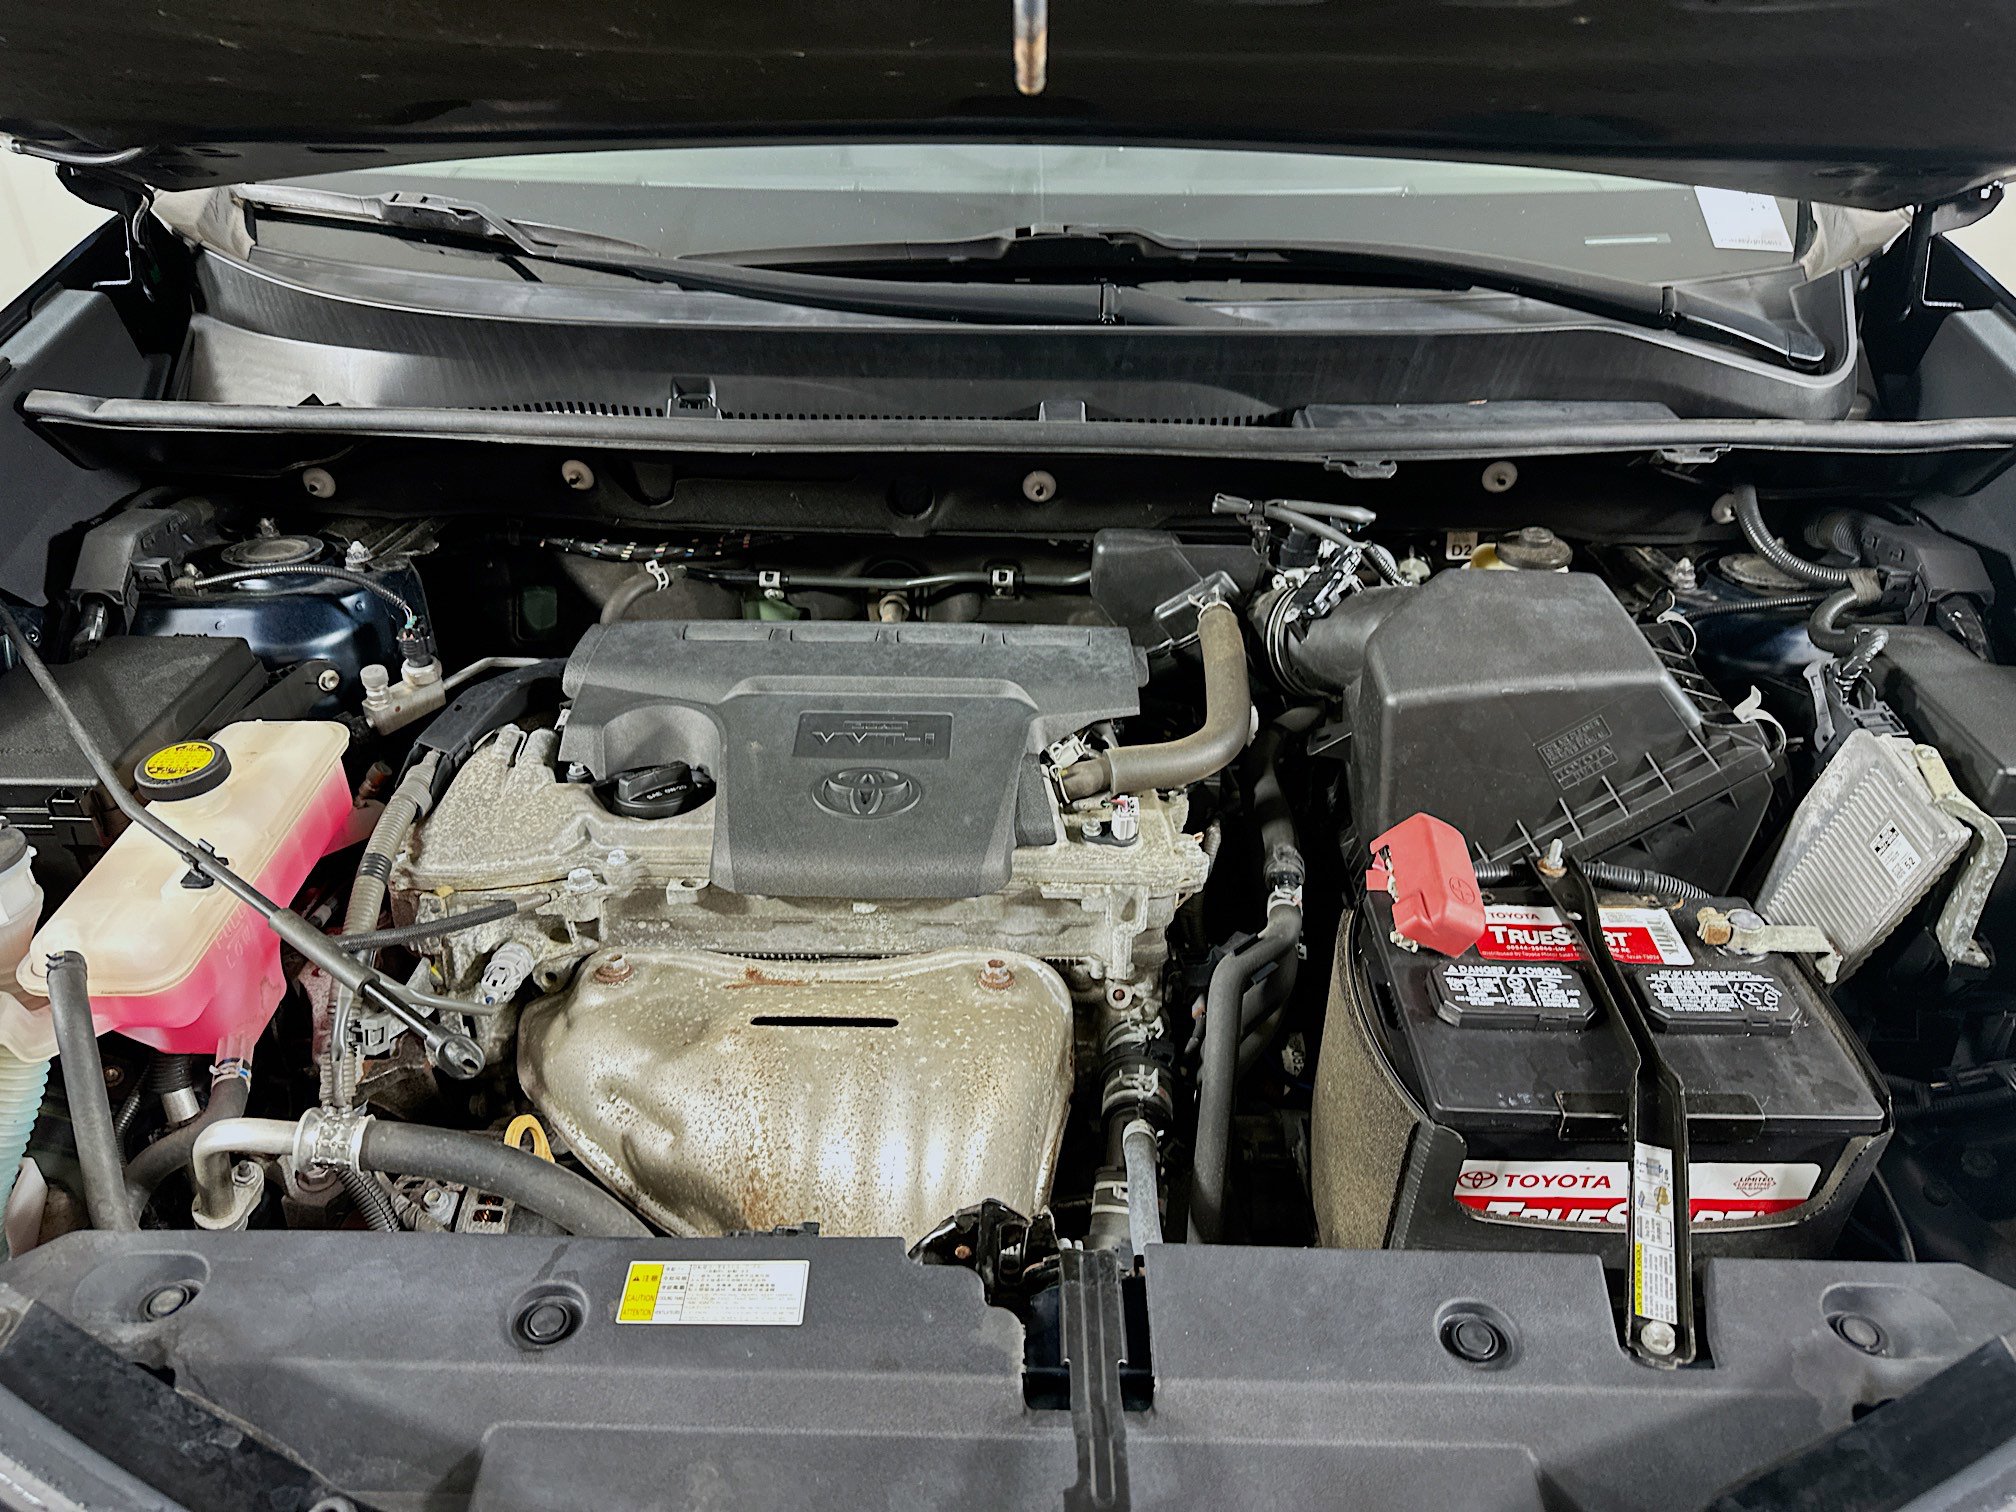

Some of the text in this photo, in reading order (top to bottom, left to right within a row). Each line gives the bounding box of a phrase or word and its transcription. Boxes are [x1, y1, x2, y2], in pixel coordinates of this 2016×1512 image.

[1451, 544, 1472, 556] D2
[1489, 911, 1540, 921] TOYOTA
[1458, 965, 1508, 976] DANGER
[1517, 966, 1562, 977] POISON
[1504, 1174, 1611, 1189] TOYOTA
[626, 1294, 655, 1302] CAUTION
[623, 1308, 651, 1317] ATTENTION
